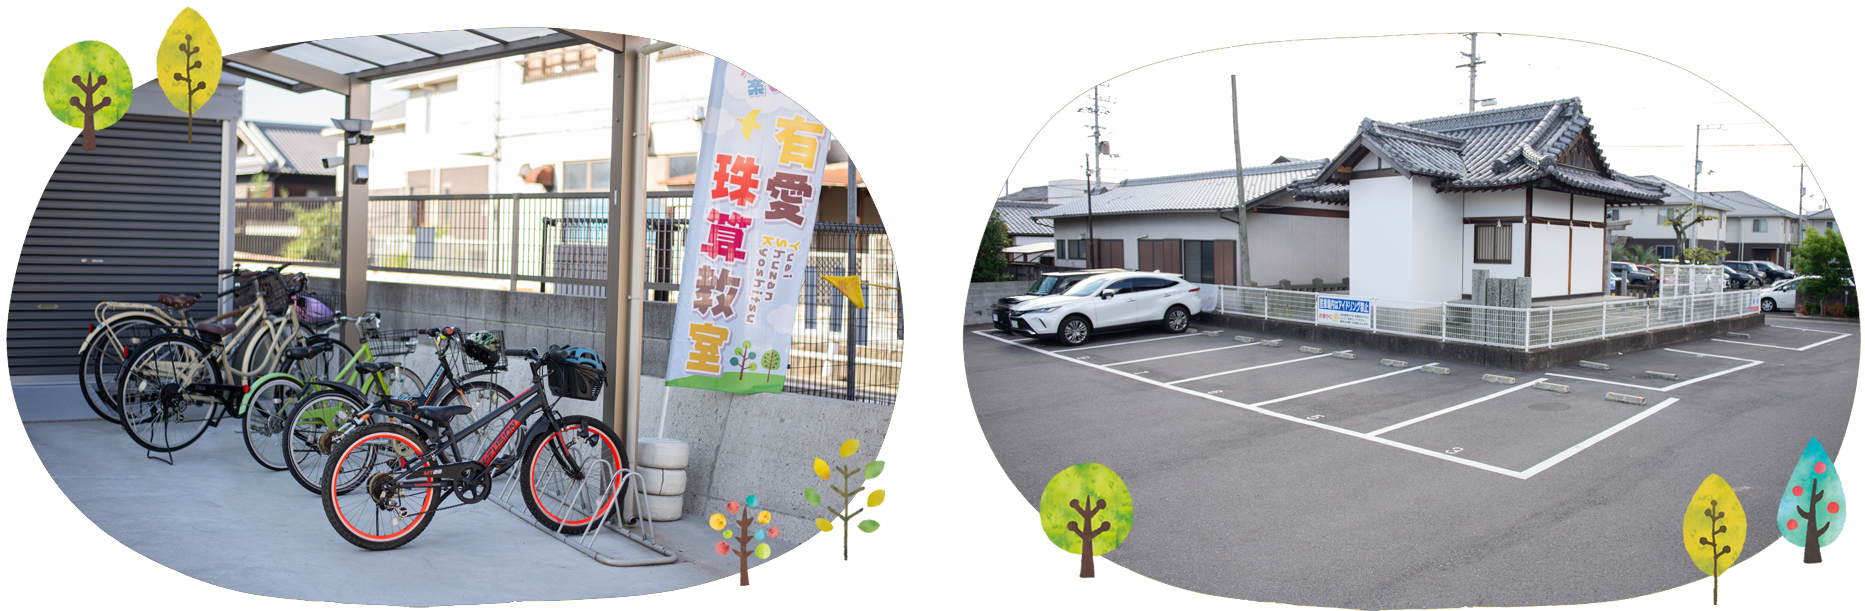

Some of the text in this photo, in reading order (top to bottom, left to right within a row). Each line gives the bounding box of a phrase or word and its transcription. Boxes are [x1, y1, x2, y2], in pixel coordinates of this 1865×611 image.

[764, 114, 825, 226] 有愛
[685, 153, 760, 374] 珠算教室
[746, 235, 774, 323] Kyoshitsu
[764, 238, 787, 301] Shuzan
[783, 241, 801, 278] Yuai
[1445, 446, 1464, 454] 3
